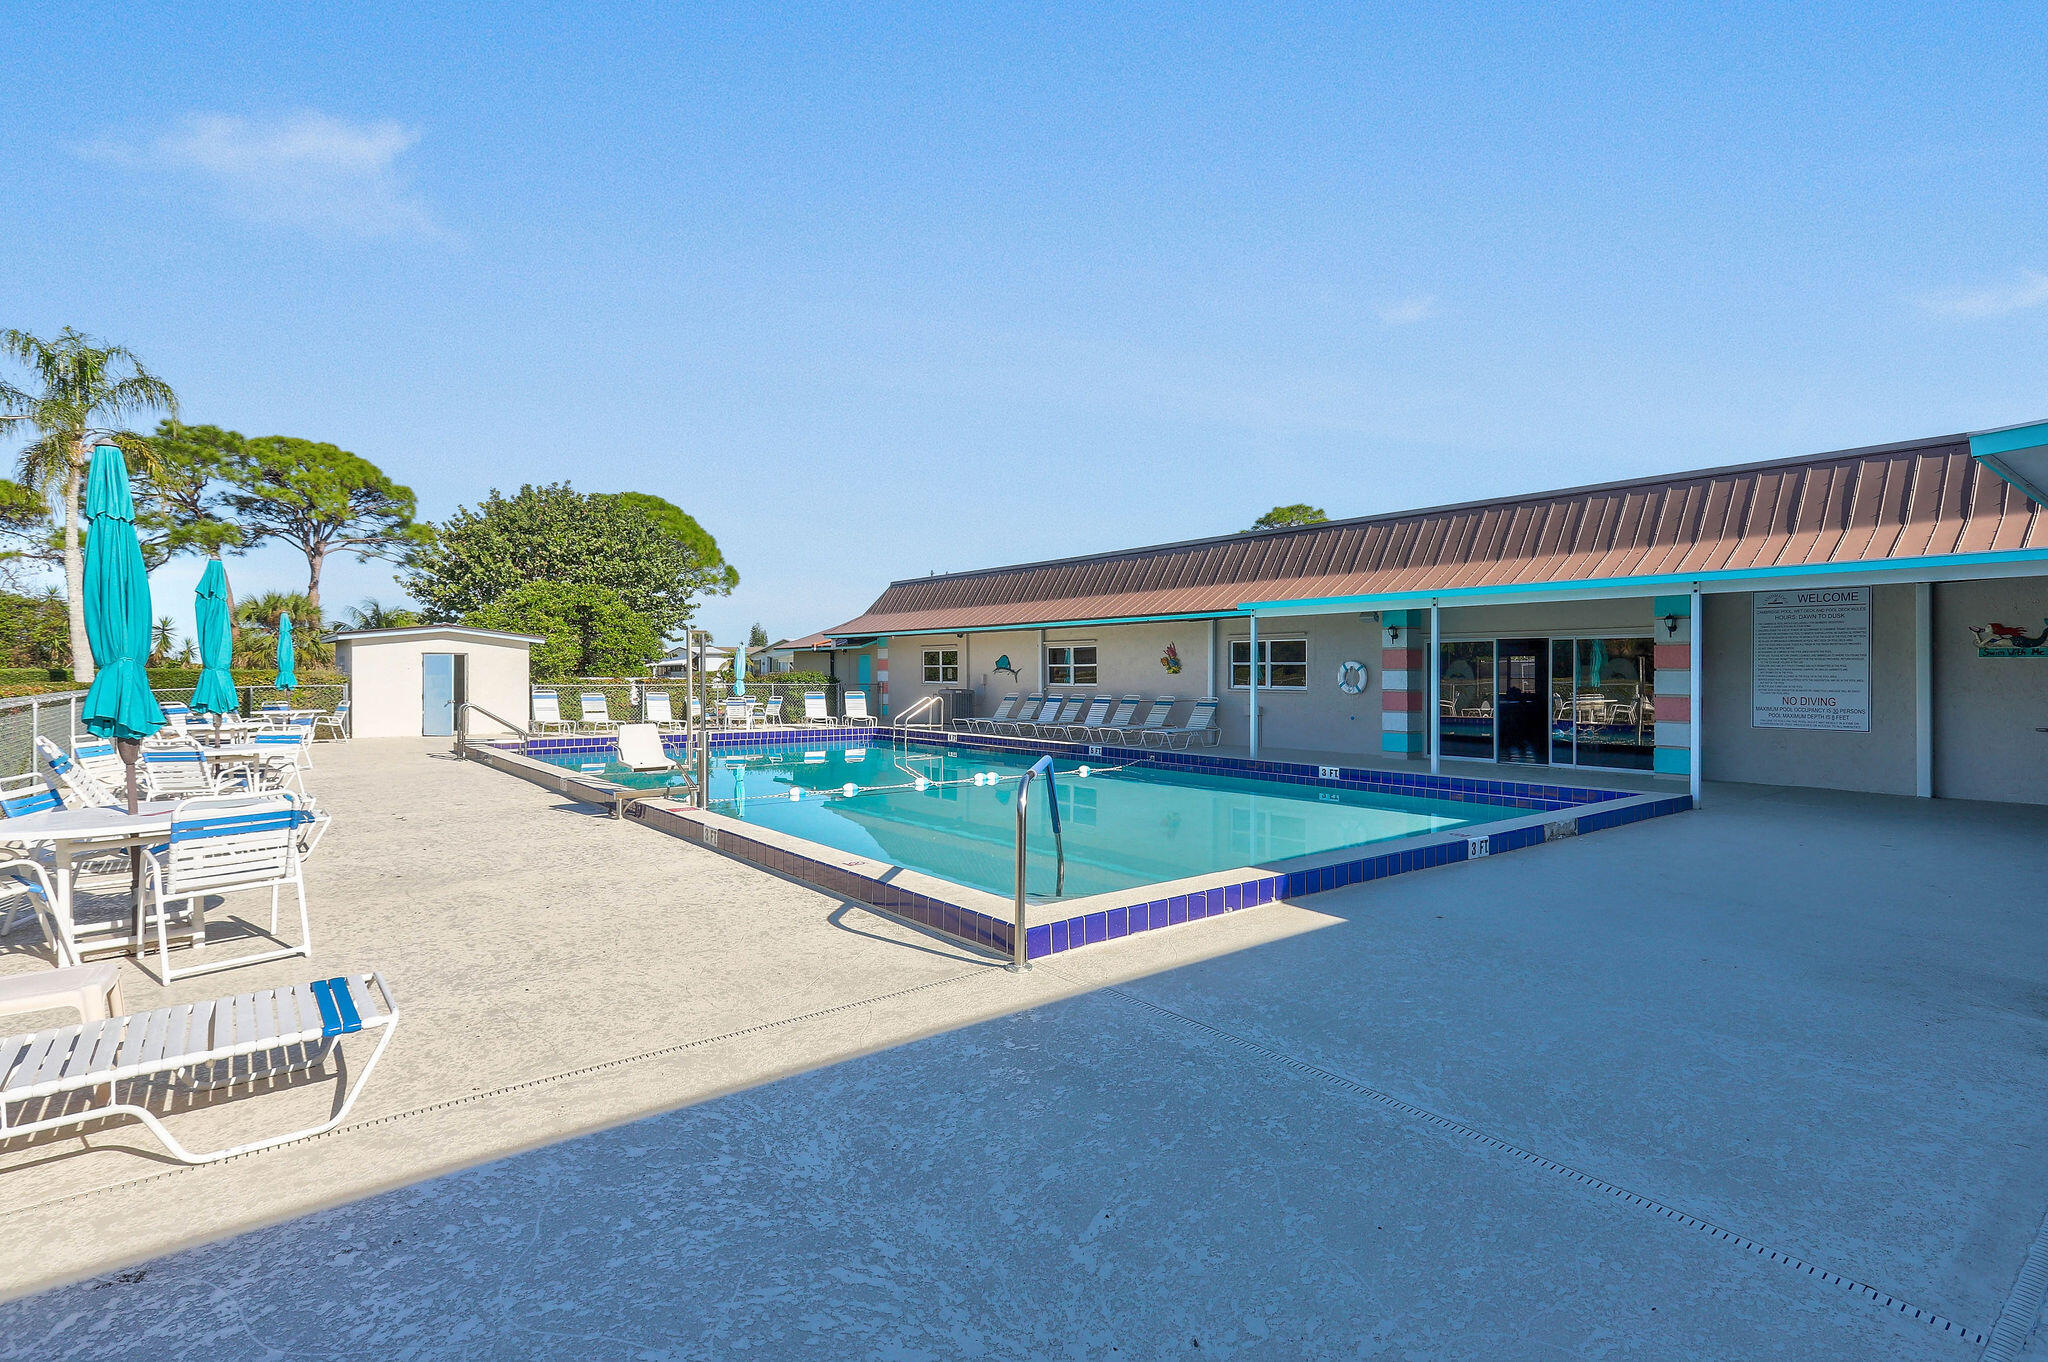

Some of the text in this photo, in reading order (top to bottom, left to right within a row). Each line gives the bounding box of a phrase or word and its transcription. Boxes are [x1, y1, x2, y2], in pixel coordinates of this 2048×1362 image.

[1798, 592, 1859, 603] WELCOME
[1983, 648, 2004, 656] Swim
[2032, 648, 2044, 656] Me
[1782, 696, 1836, 706] NO DIVING
[1322, 768, 1339, 778] 3 FT
[1472, 839, 1488, 855] 3 FT
